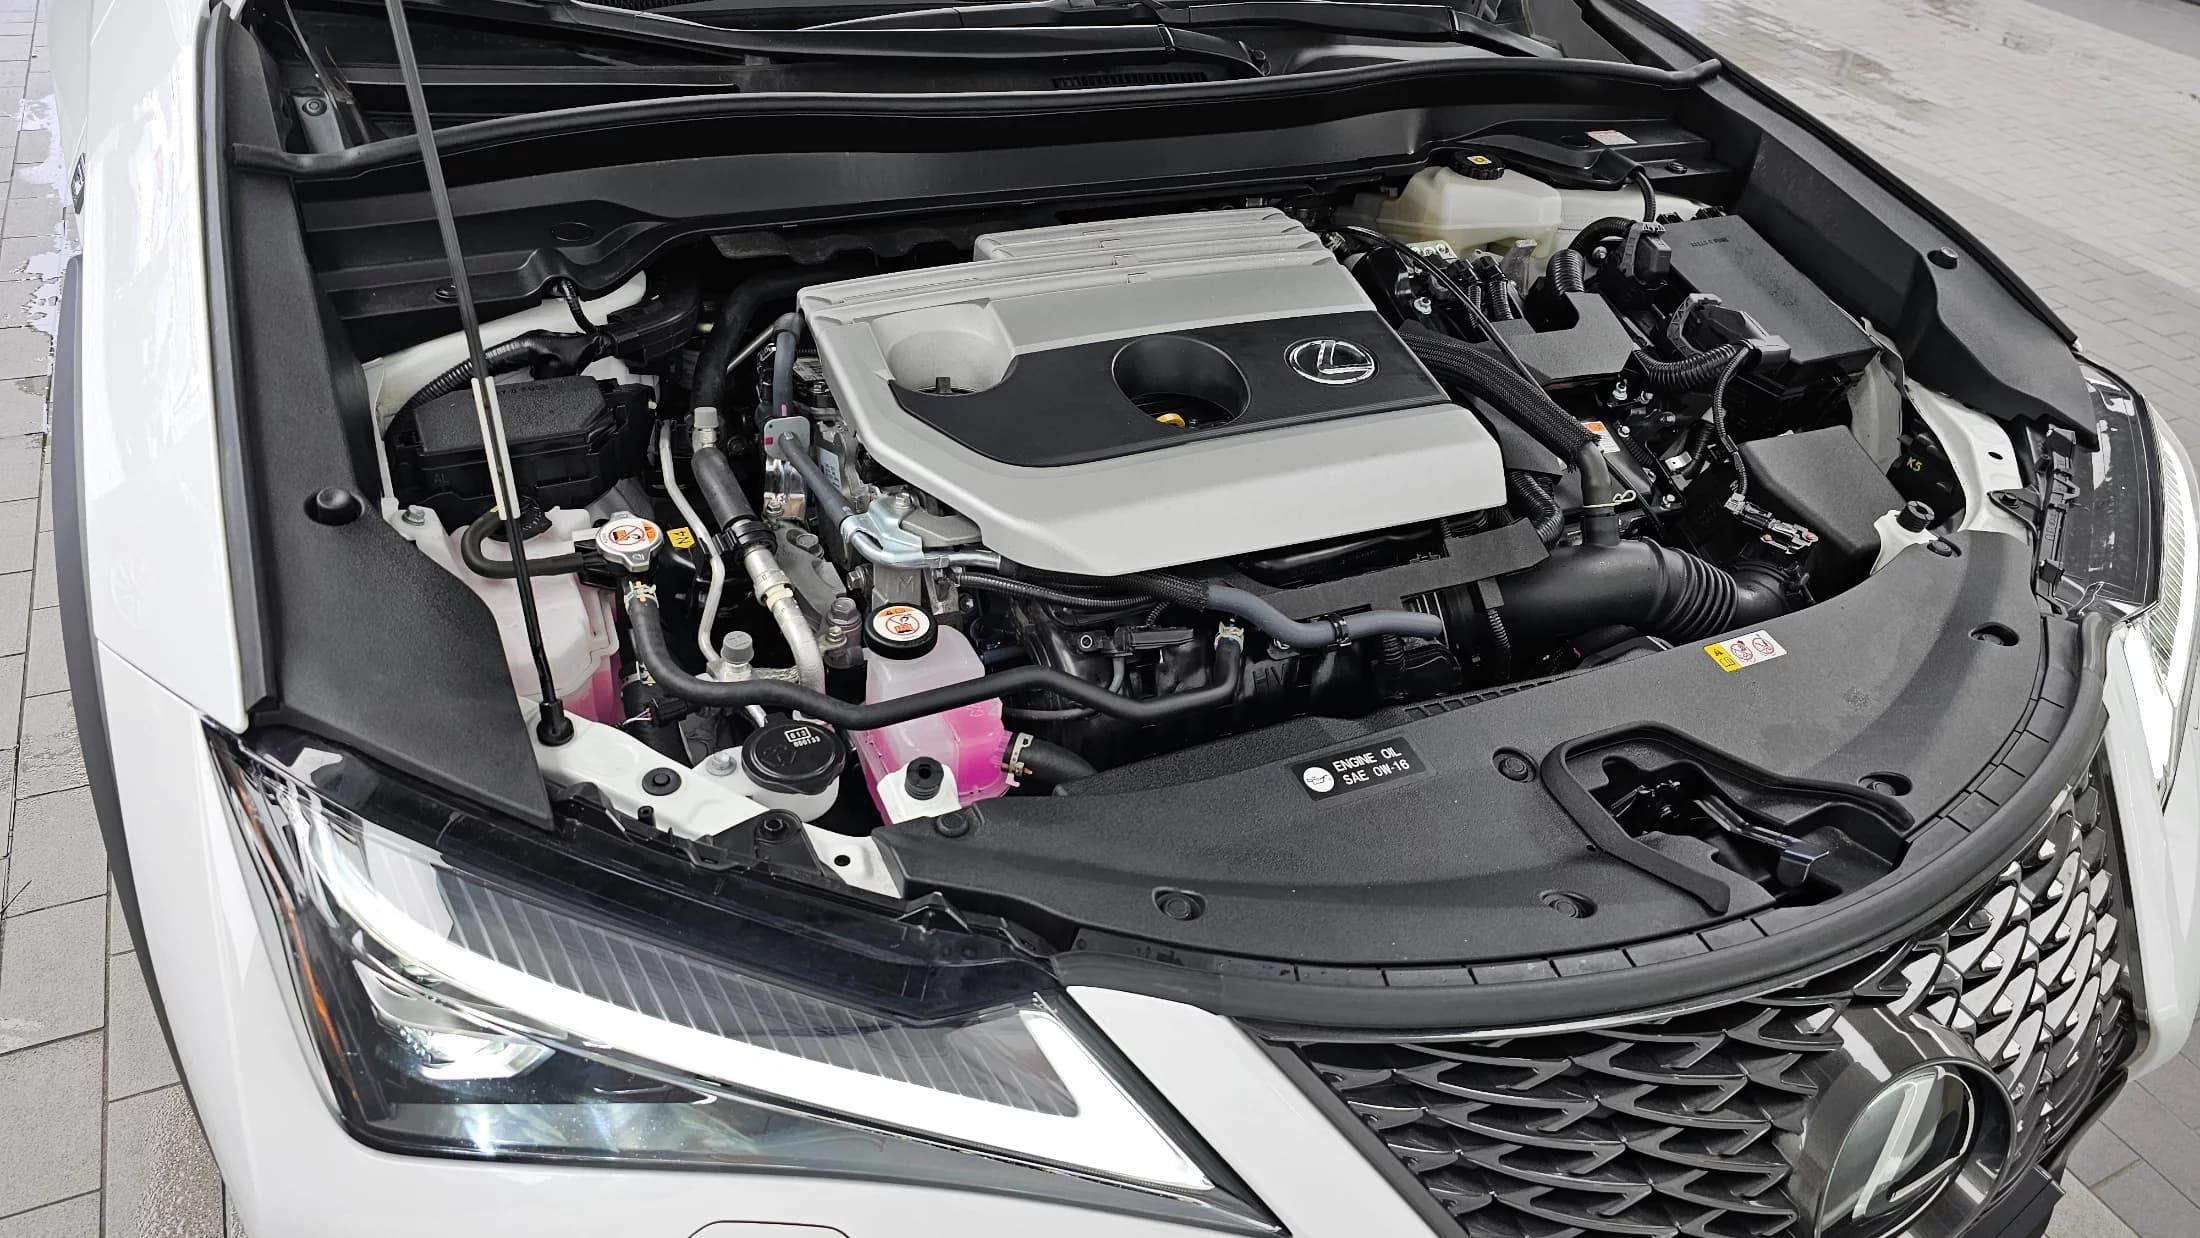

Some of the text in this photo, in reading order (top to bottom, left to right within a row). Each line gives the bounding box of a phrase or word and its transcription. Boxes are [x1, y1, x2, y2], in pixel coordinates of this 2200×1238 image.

[1333, 747, 1402, 772] ENGINE OIL
[1343, 760, 1410, 785] SAE 0W-16
